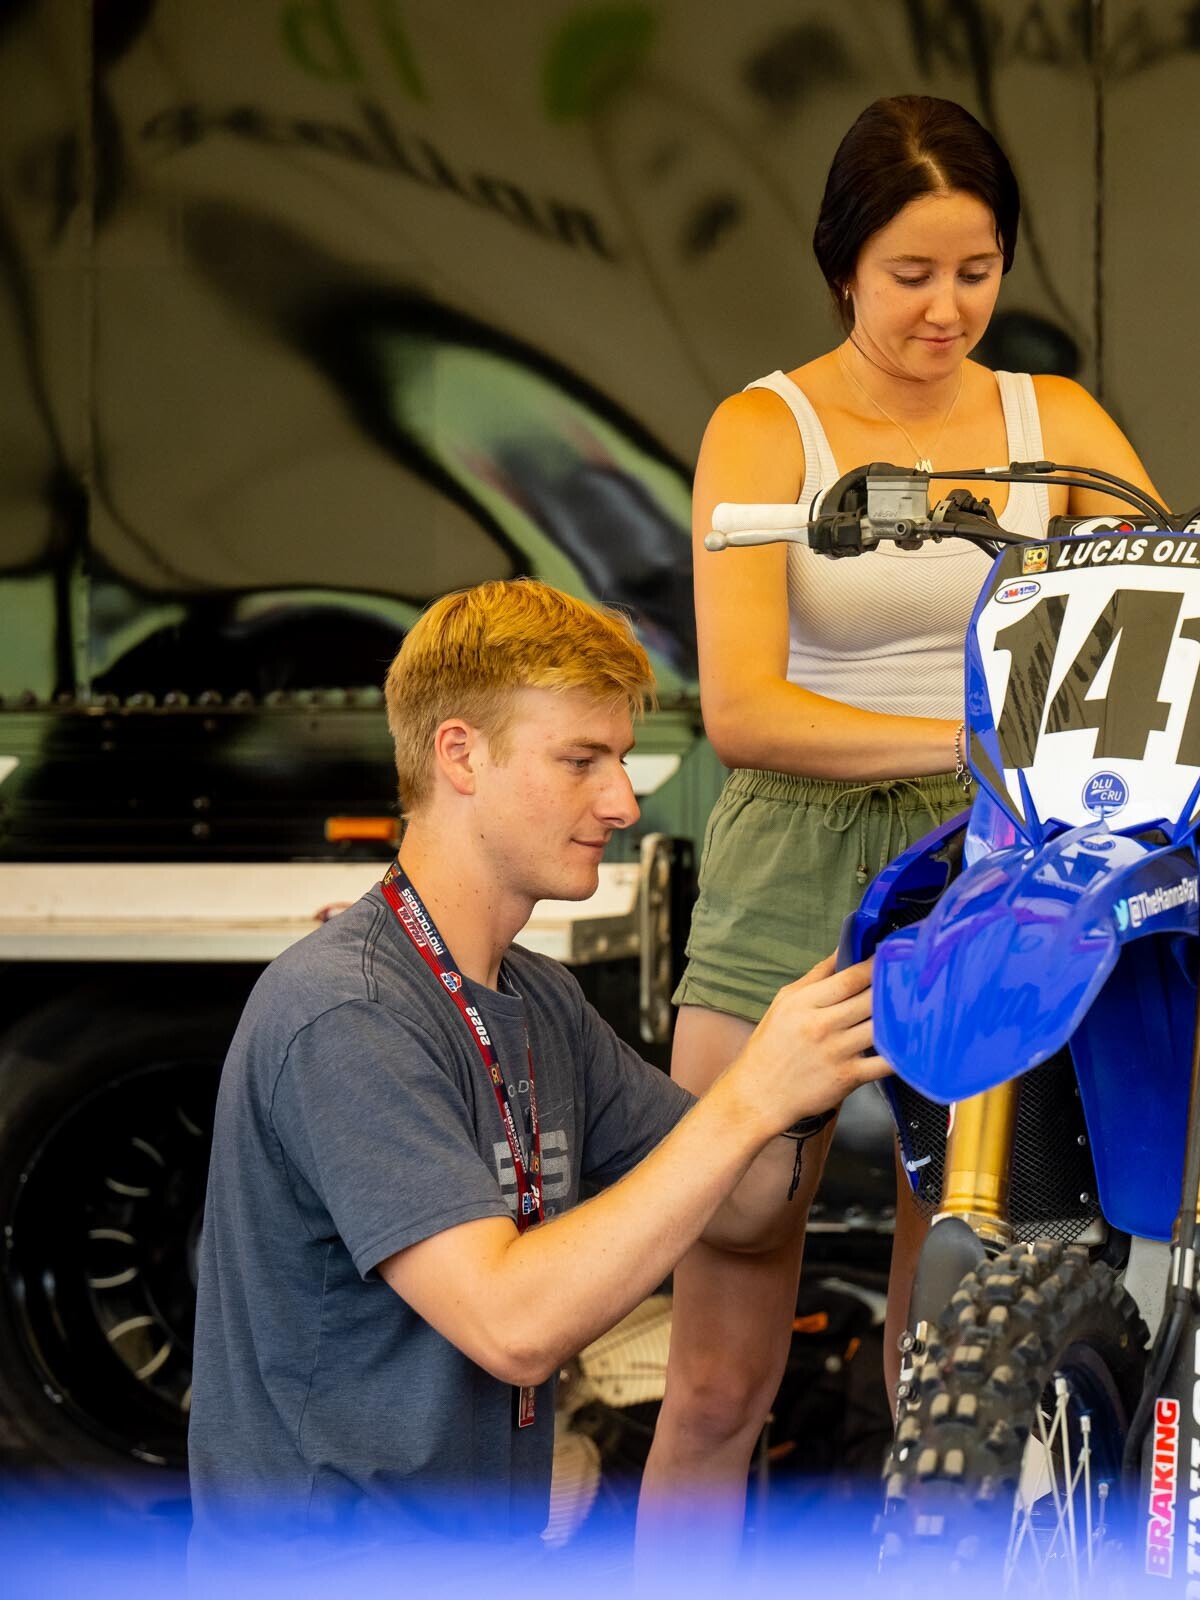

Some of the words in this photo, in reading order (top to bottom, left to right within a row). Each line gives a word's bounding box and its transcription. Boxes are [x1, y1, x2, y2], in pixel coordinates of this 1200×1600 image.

[1025, 547, 1048, 565] 50
[1055, 539, 1149, 568] LUCAS
[1152, 540, 1198, 565] OIL
[401, 888, 444, 956] MOTOCROSS
[1128, 876, 1199, 928] @TheHannaRay
[465, 1006, 491, 1046] 2022
[1149, 1400, 1177, 1576] BRAKING
